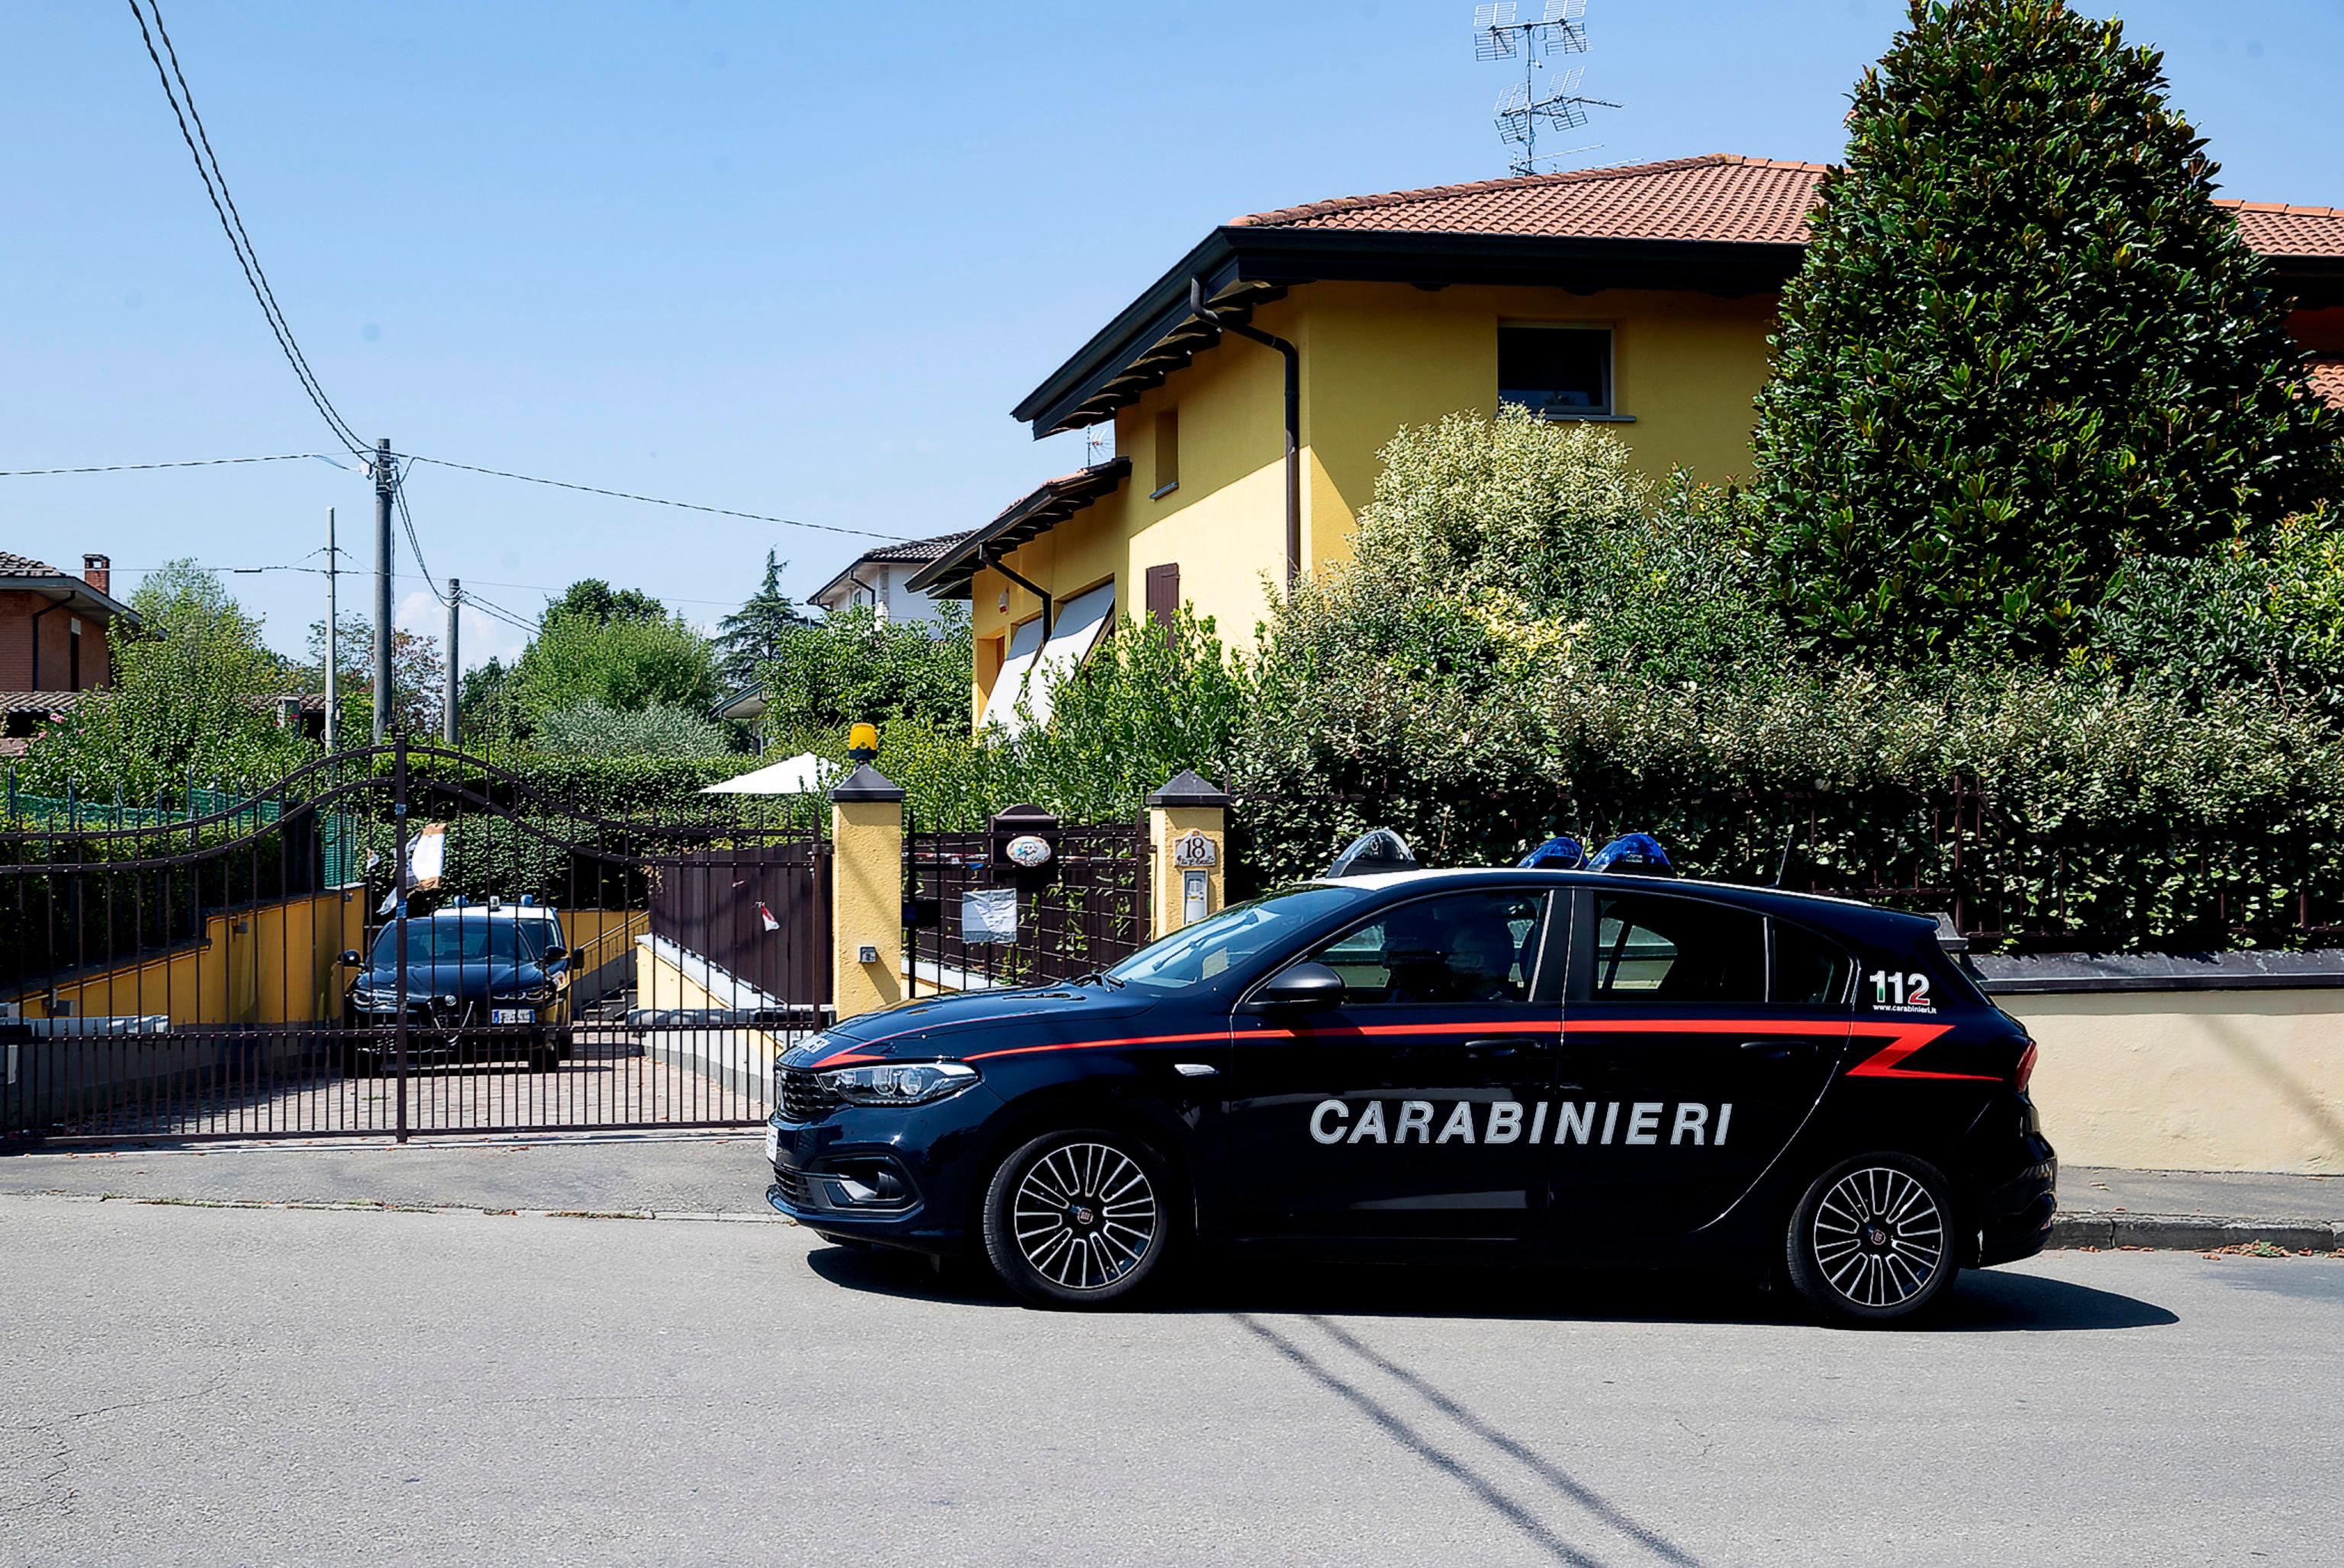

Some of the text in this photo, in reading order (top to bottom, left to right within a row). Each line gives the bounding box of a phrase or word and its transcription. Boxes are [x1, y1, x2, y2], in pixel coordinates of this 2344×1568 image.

[1186, 838, 1206, 858] 18
[1869, 971, 1930, 1006] 112
[1872, 1005, 1937, 1014] www.carabinieri.it
[1310, 1100, 1733, 1145] CARABINIERI
